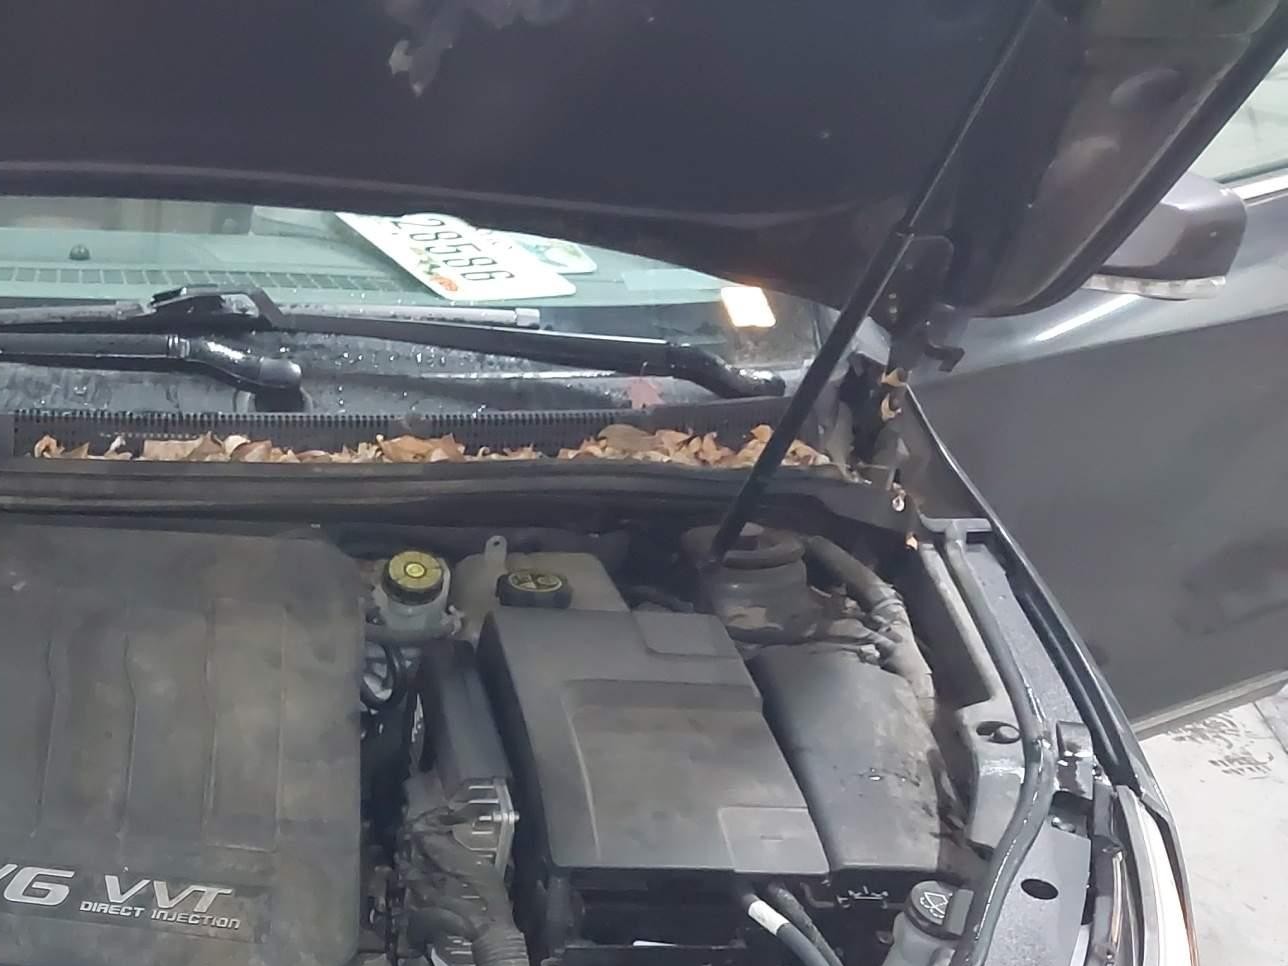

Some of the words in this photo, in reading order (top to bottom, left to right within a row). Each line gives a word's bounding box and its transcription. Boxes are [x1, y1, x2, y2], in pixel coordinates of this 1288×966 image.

[104, 874, 233, 913] VVT
[79, 900, 145, 918] DIRECT
[151, 909, 241, 930] INJECTION
